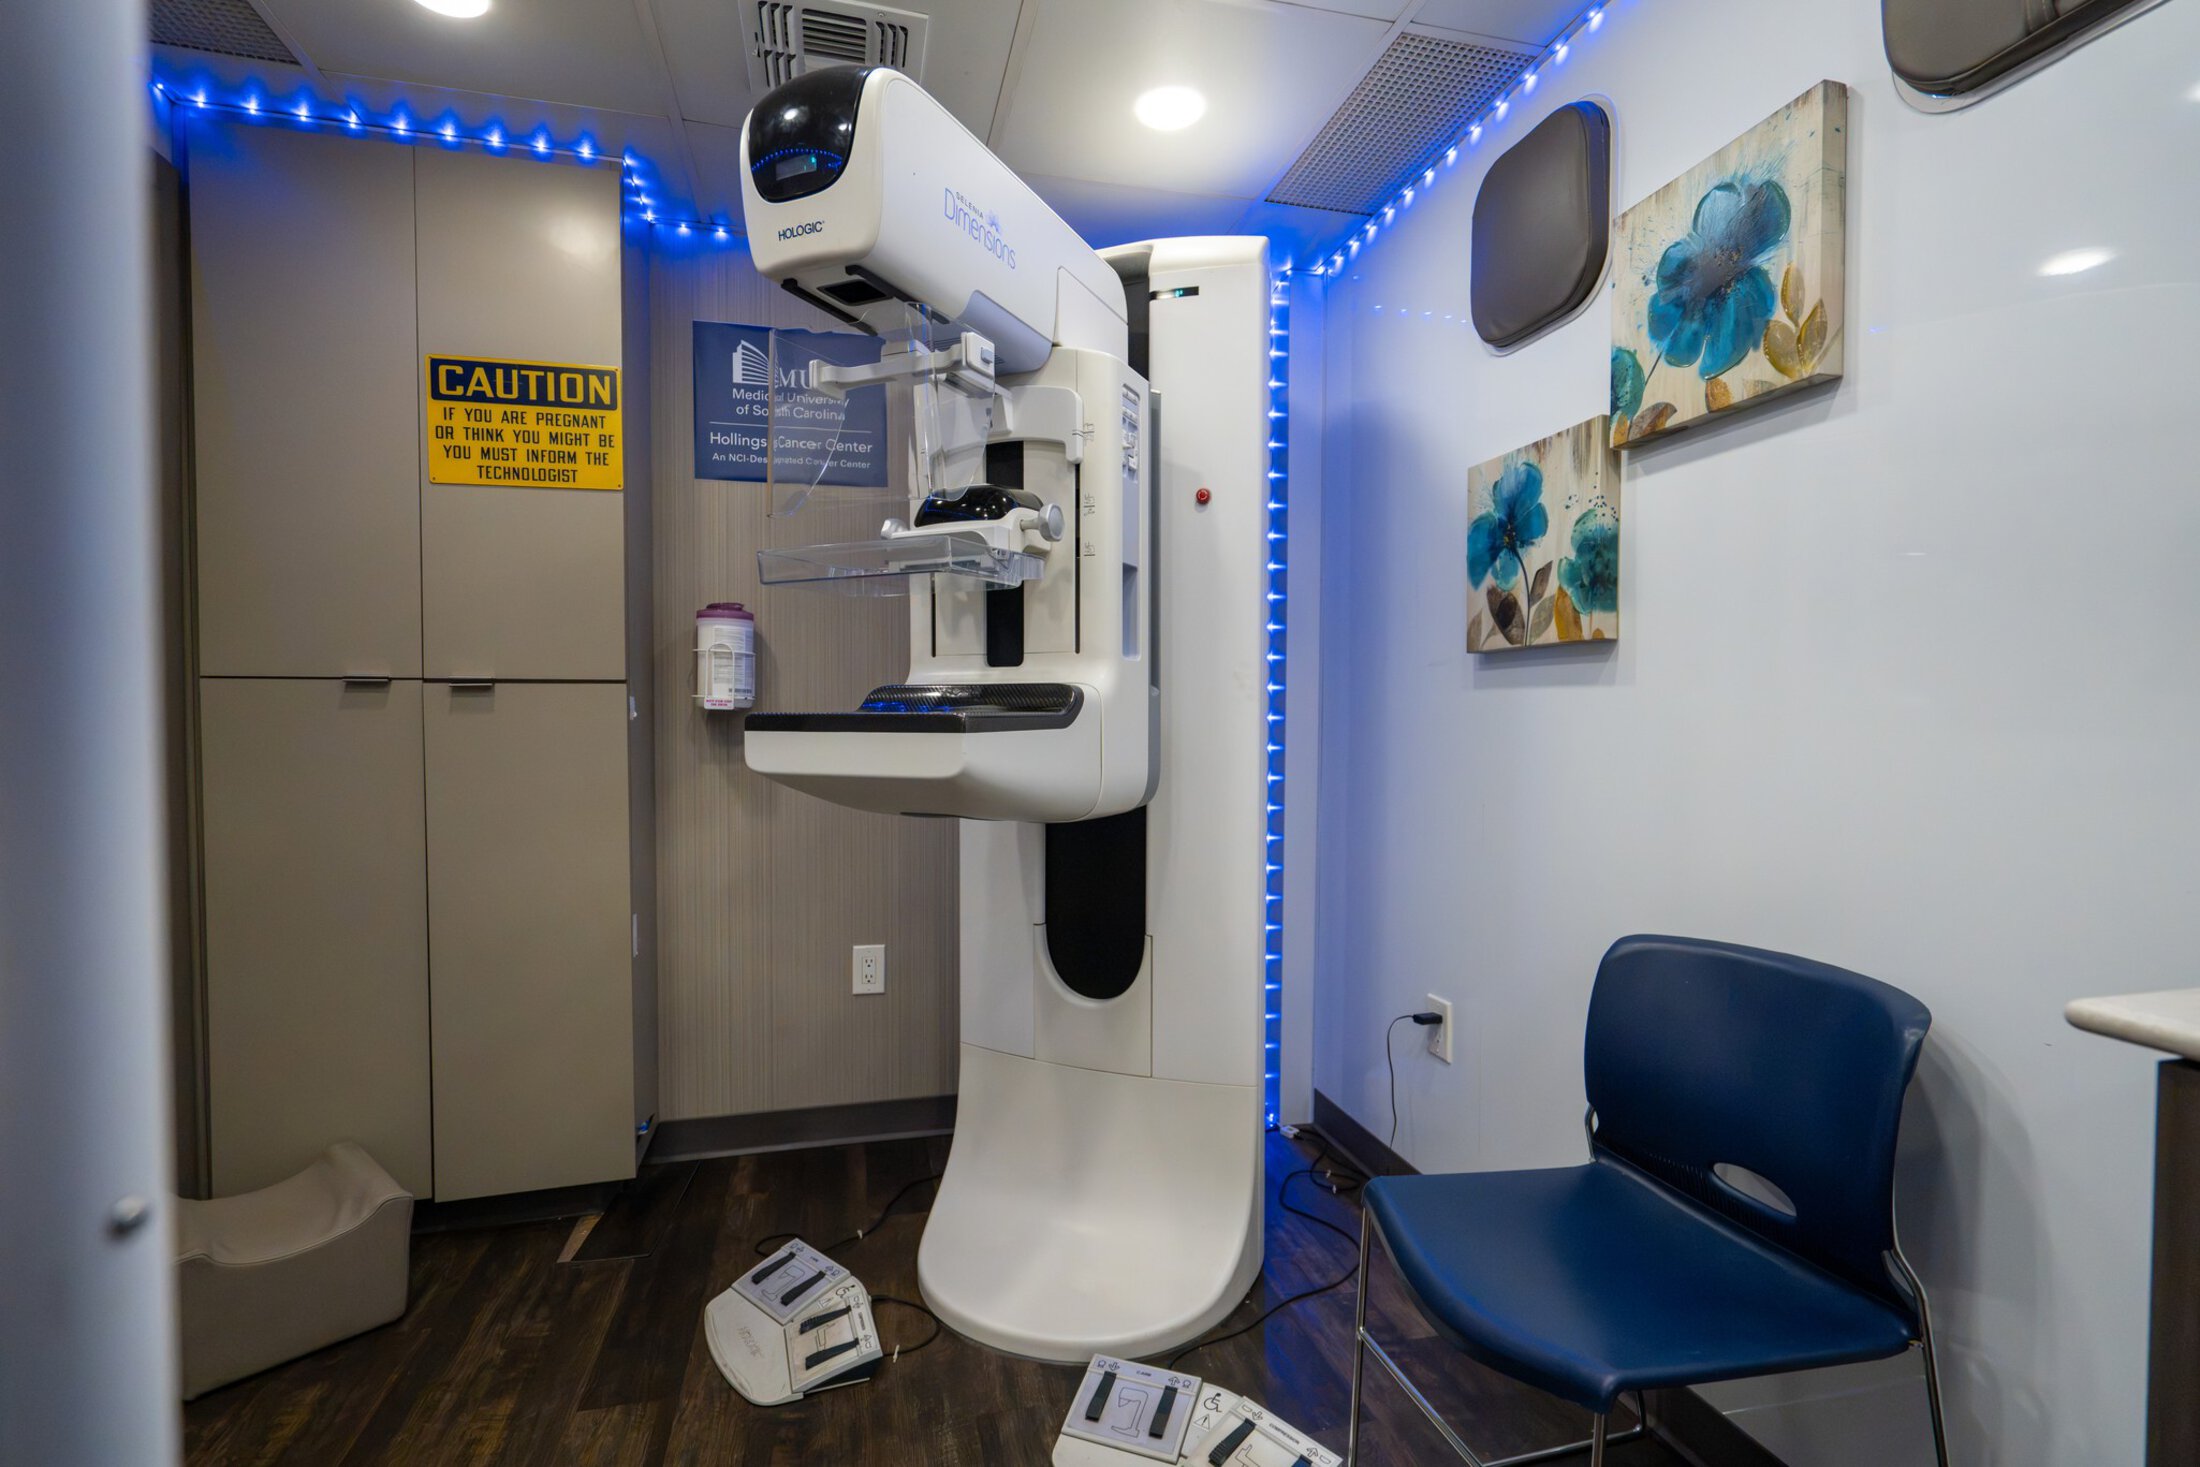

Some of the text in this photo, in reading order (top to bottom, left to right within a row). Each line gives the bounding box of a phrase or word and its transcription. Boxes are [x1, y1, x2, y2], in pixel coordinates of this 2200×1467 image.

[956, 191, 984, 219] SELENIA
[777, 220, 823, 241] HOLOGIC
[944, 187, 1016, 270] Dimensions
[437, 364, 611, 405] CAUTION
[778, 367, 812, 390] MU
[443, 407, 606, 429] IF YOU ARE PREGNANT
[736, 404, 749, 415] of
[793, 406, 846, 421] Carolina
[435, 425, 615, 448] OR THINK YOU MIGHT BE
[710, 432, 873, 453] Hollings Cancer Center
[443, 445, 609, 466] YOU MUST INFORM THE
[712, 452, 726, 461] An
[728, 453, 804, 465] NCI-Desgnated
[840, 459, 871, 469] Center
[477, 465, 578, 483] TECHNOLOGIST
